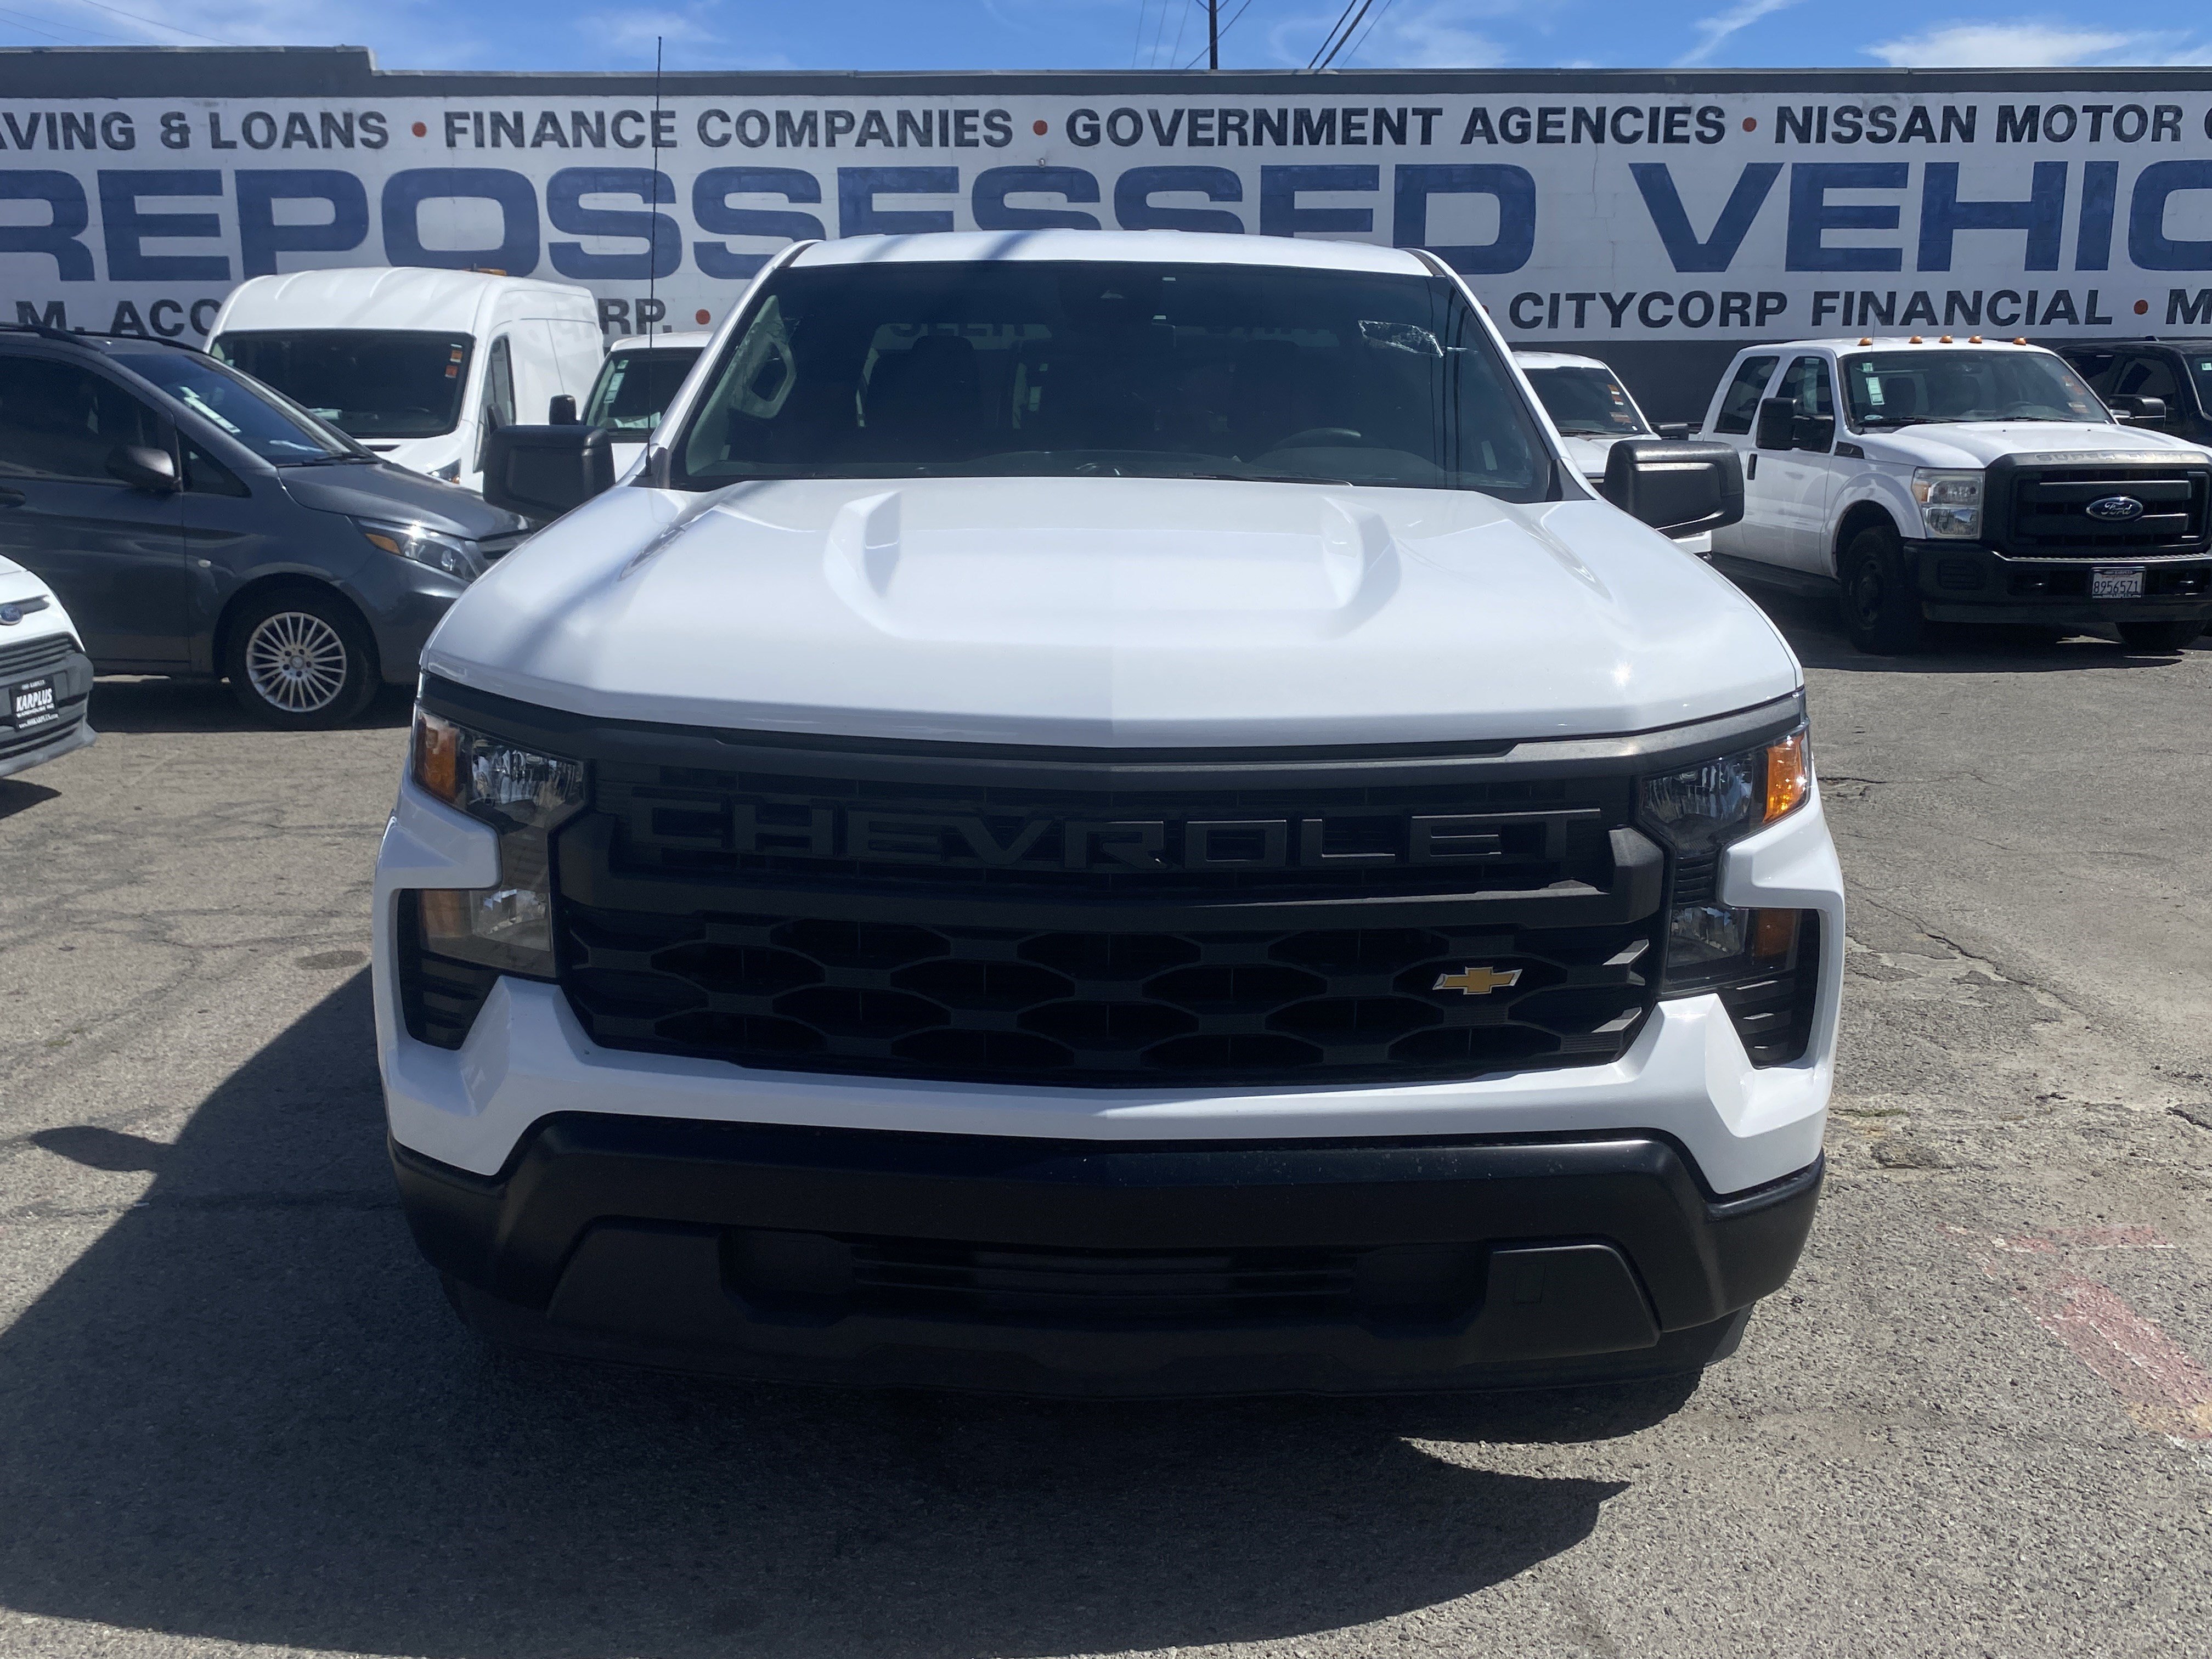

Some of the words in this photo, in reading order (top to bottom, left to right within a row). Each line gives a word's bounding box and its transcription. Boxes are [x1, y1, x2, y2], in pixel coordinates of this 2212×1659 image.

[0, 111, 136, 150] VING
[160, 111, 191, 149] &
[209, 111, 388, 149] LOANS
[444, 109, 677, 148] FINANCE
[697, 109, 1013, 148] COMPANIES
[1066, 107, 1443, 146] GOVERNMENT
[1460, 105, 1725, 144] AGENCIES
[1775, 105, 1977, 143] NISSAN
[1996, 104, 2183, 143] MOTOR
[1509, 291, 1787, 329] CITYCORP
[1811, 289, 2113, 326] FINANCIAL
[2101, 501, 2131, 515] Ford
[16, 688, 53, 712] KARPLUS
[631, 793, 1601, 869] CHEVROLET
